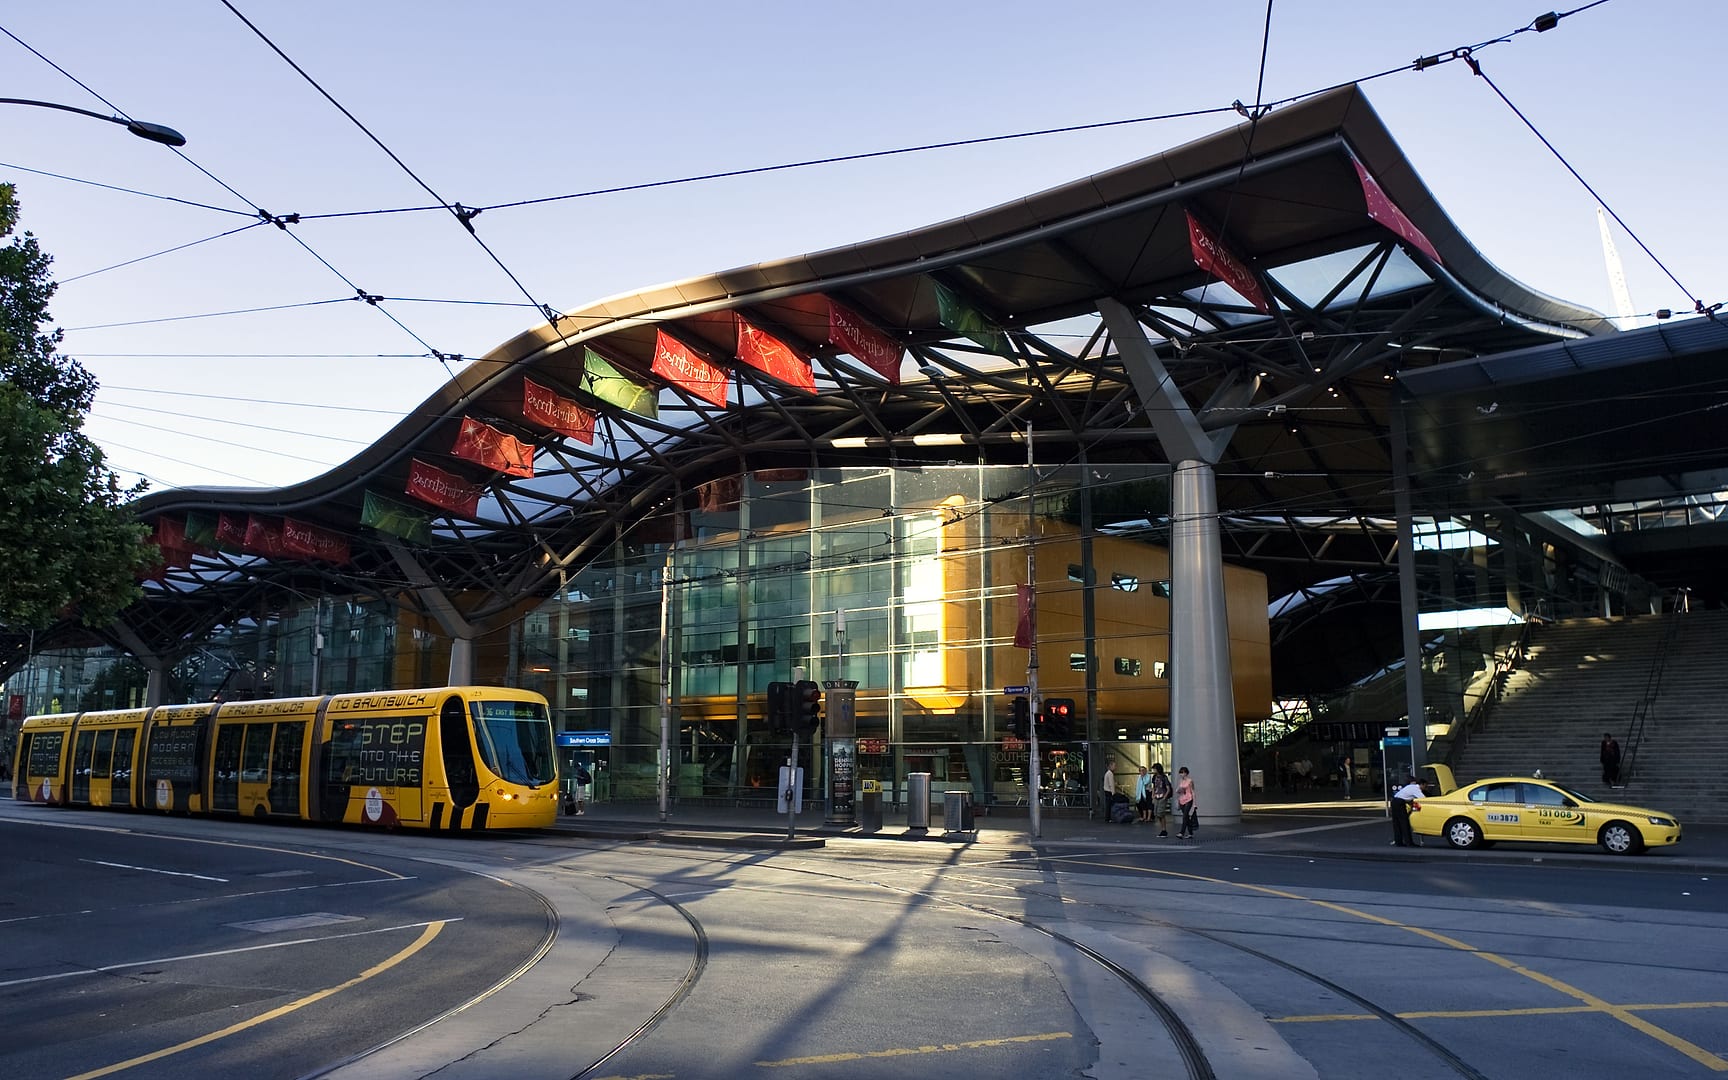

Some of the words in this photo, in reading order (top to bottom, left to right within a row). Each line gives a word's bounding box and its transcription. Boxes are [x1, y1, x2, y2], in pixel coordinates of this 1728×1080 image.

[227, 704, 256, 715] FROM
[256, 703, 270, 713] ST
[273, 702, 304, 712] KILDA
[335, 699, 348, 710] TO
[352, 694, 426, 709] BRUNSWICK
[360, 723, 423, 745] STEP
[33, 735, 62, 750] STEP
[152, 743, 194, 753] MODERN
[388, 750, 421, 762] THE
[991, 751, 1044, 762] SOUTHEN
[359, 767, 420, 783] FUTURE
[1539, 809, 1552, 817] 131
